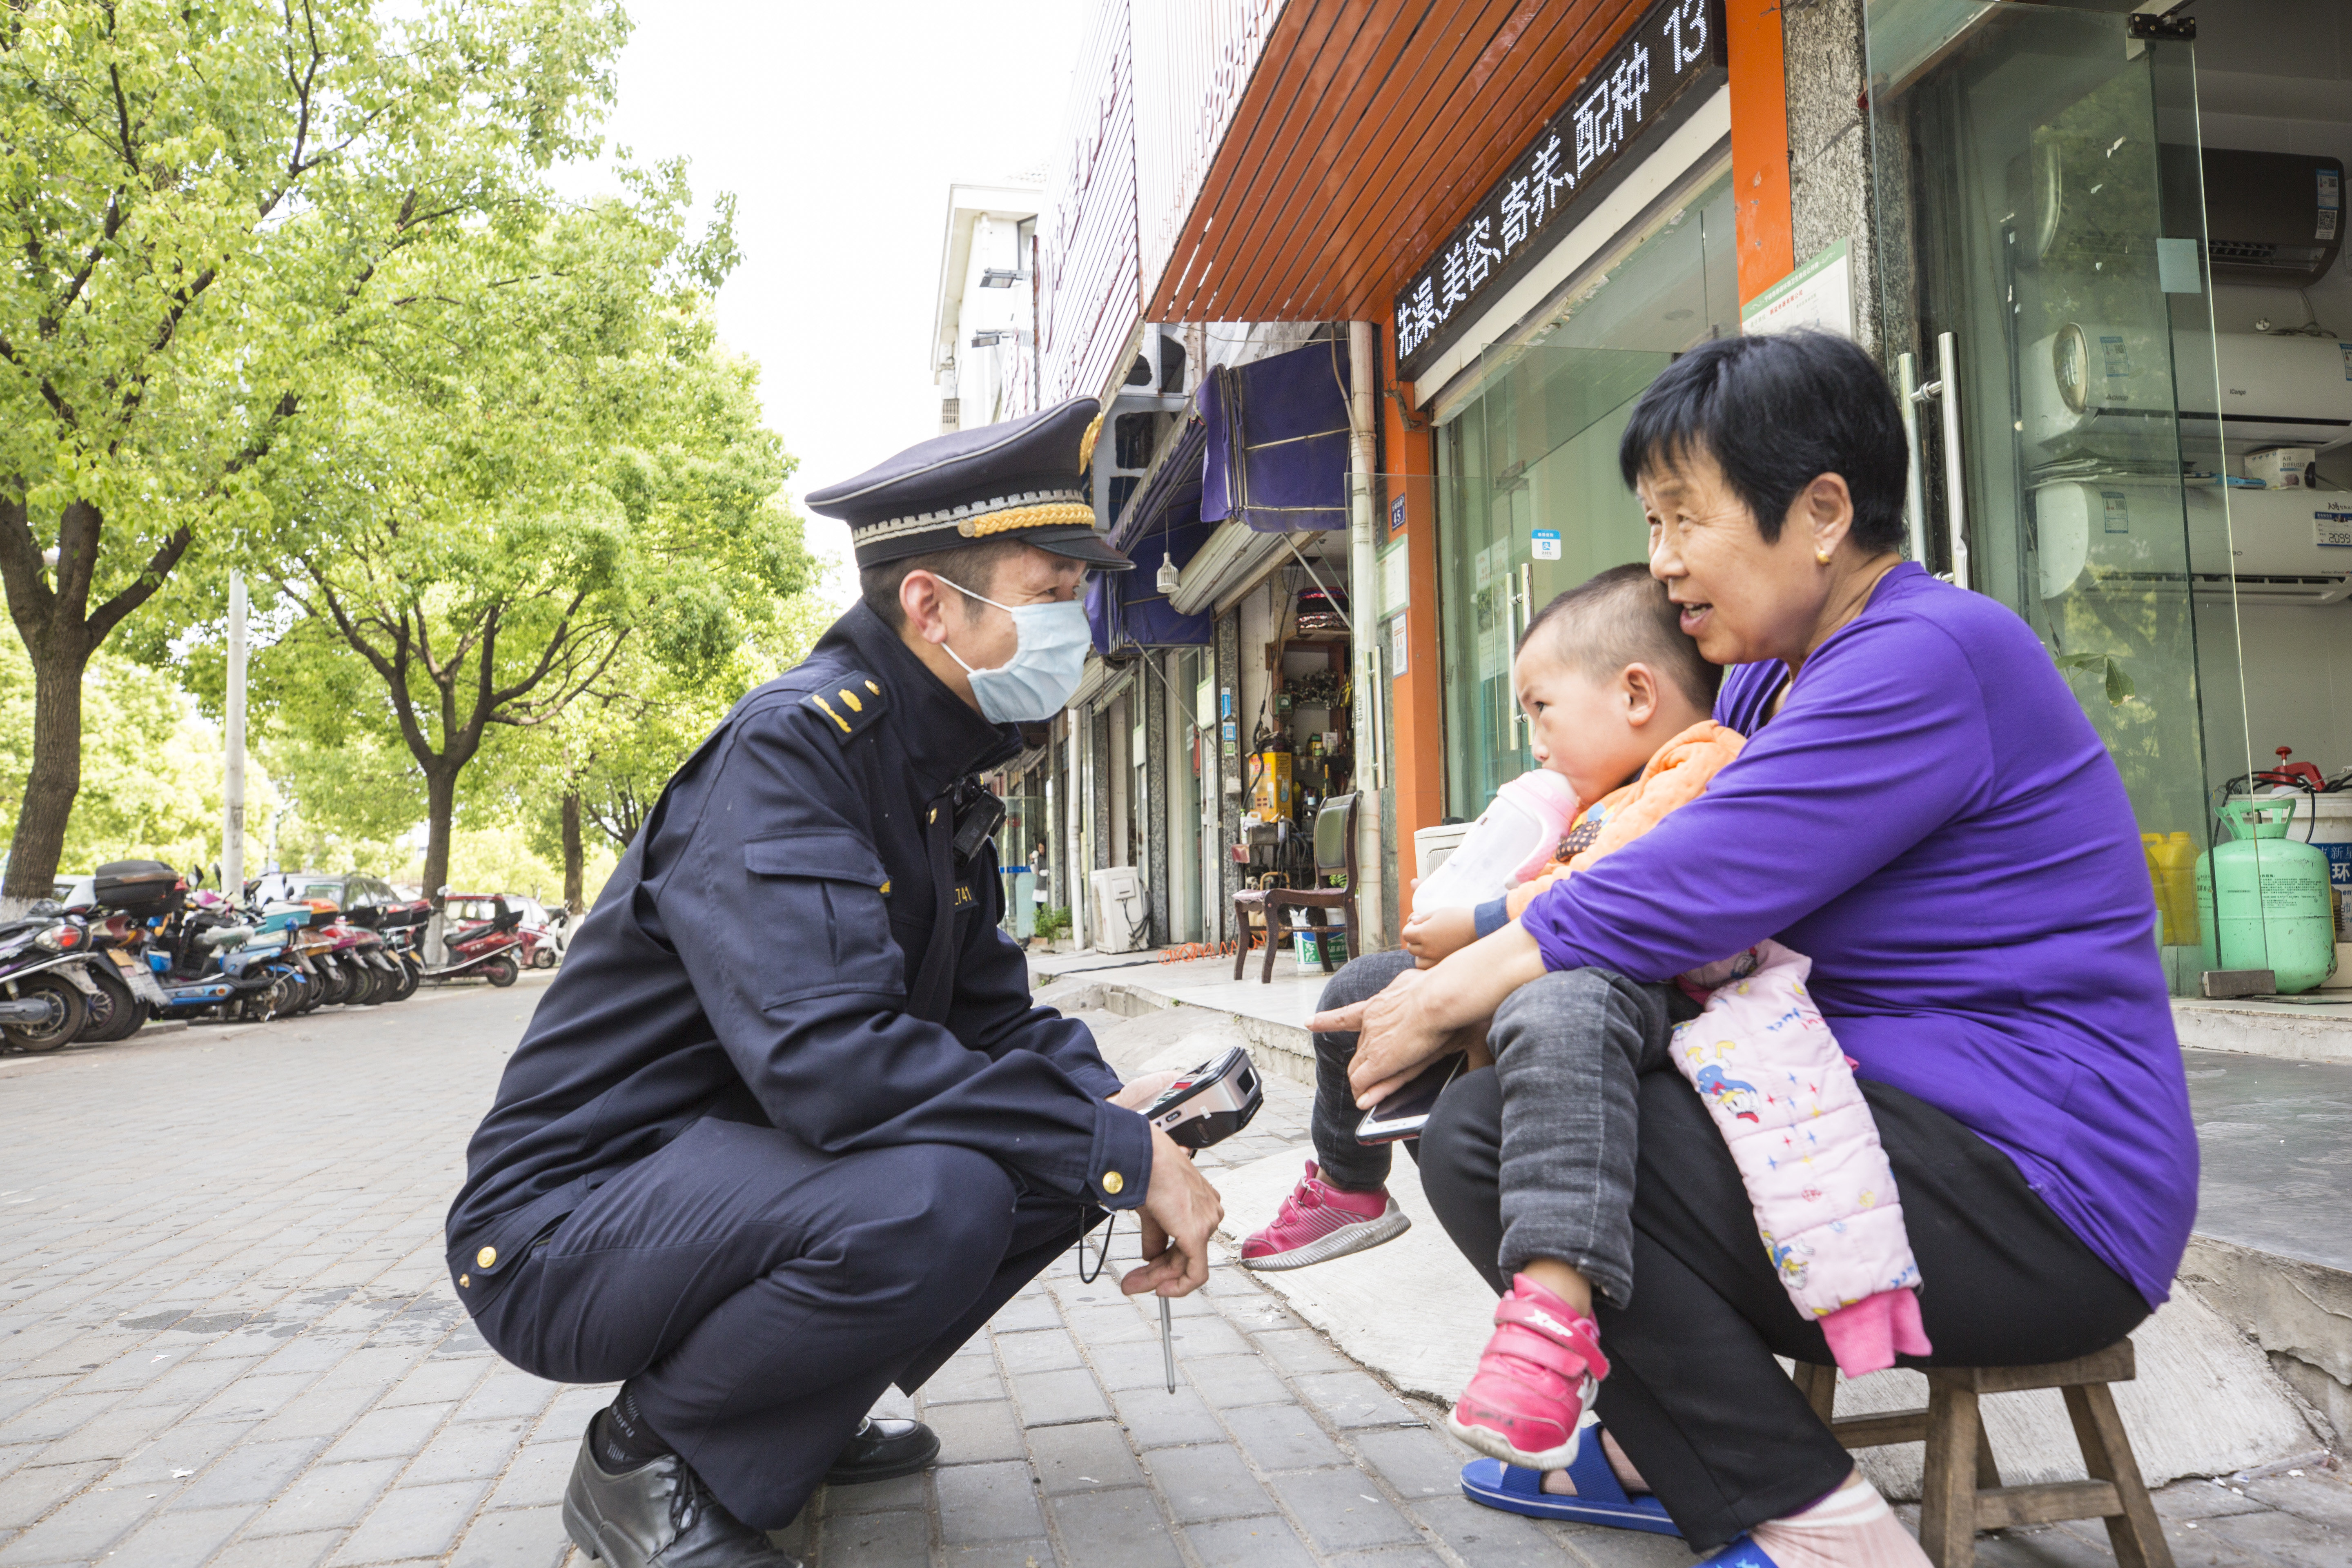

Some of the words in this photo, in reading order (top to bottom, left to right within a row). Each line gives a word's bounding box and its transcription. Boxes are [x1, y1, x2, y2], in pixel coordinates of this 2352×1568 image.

[1664, 0, 1707, 74] 13
[2332, 863, 2350, 882] 环
[955, 886, 972, 905] 741
